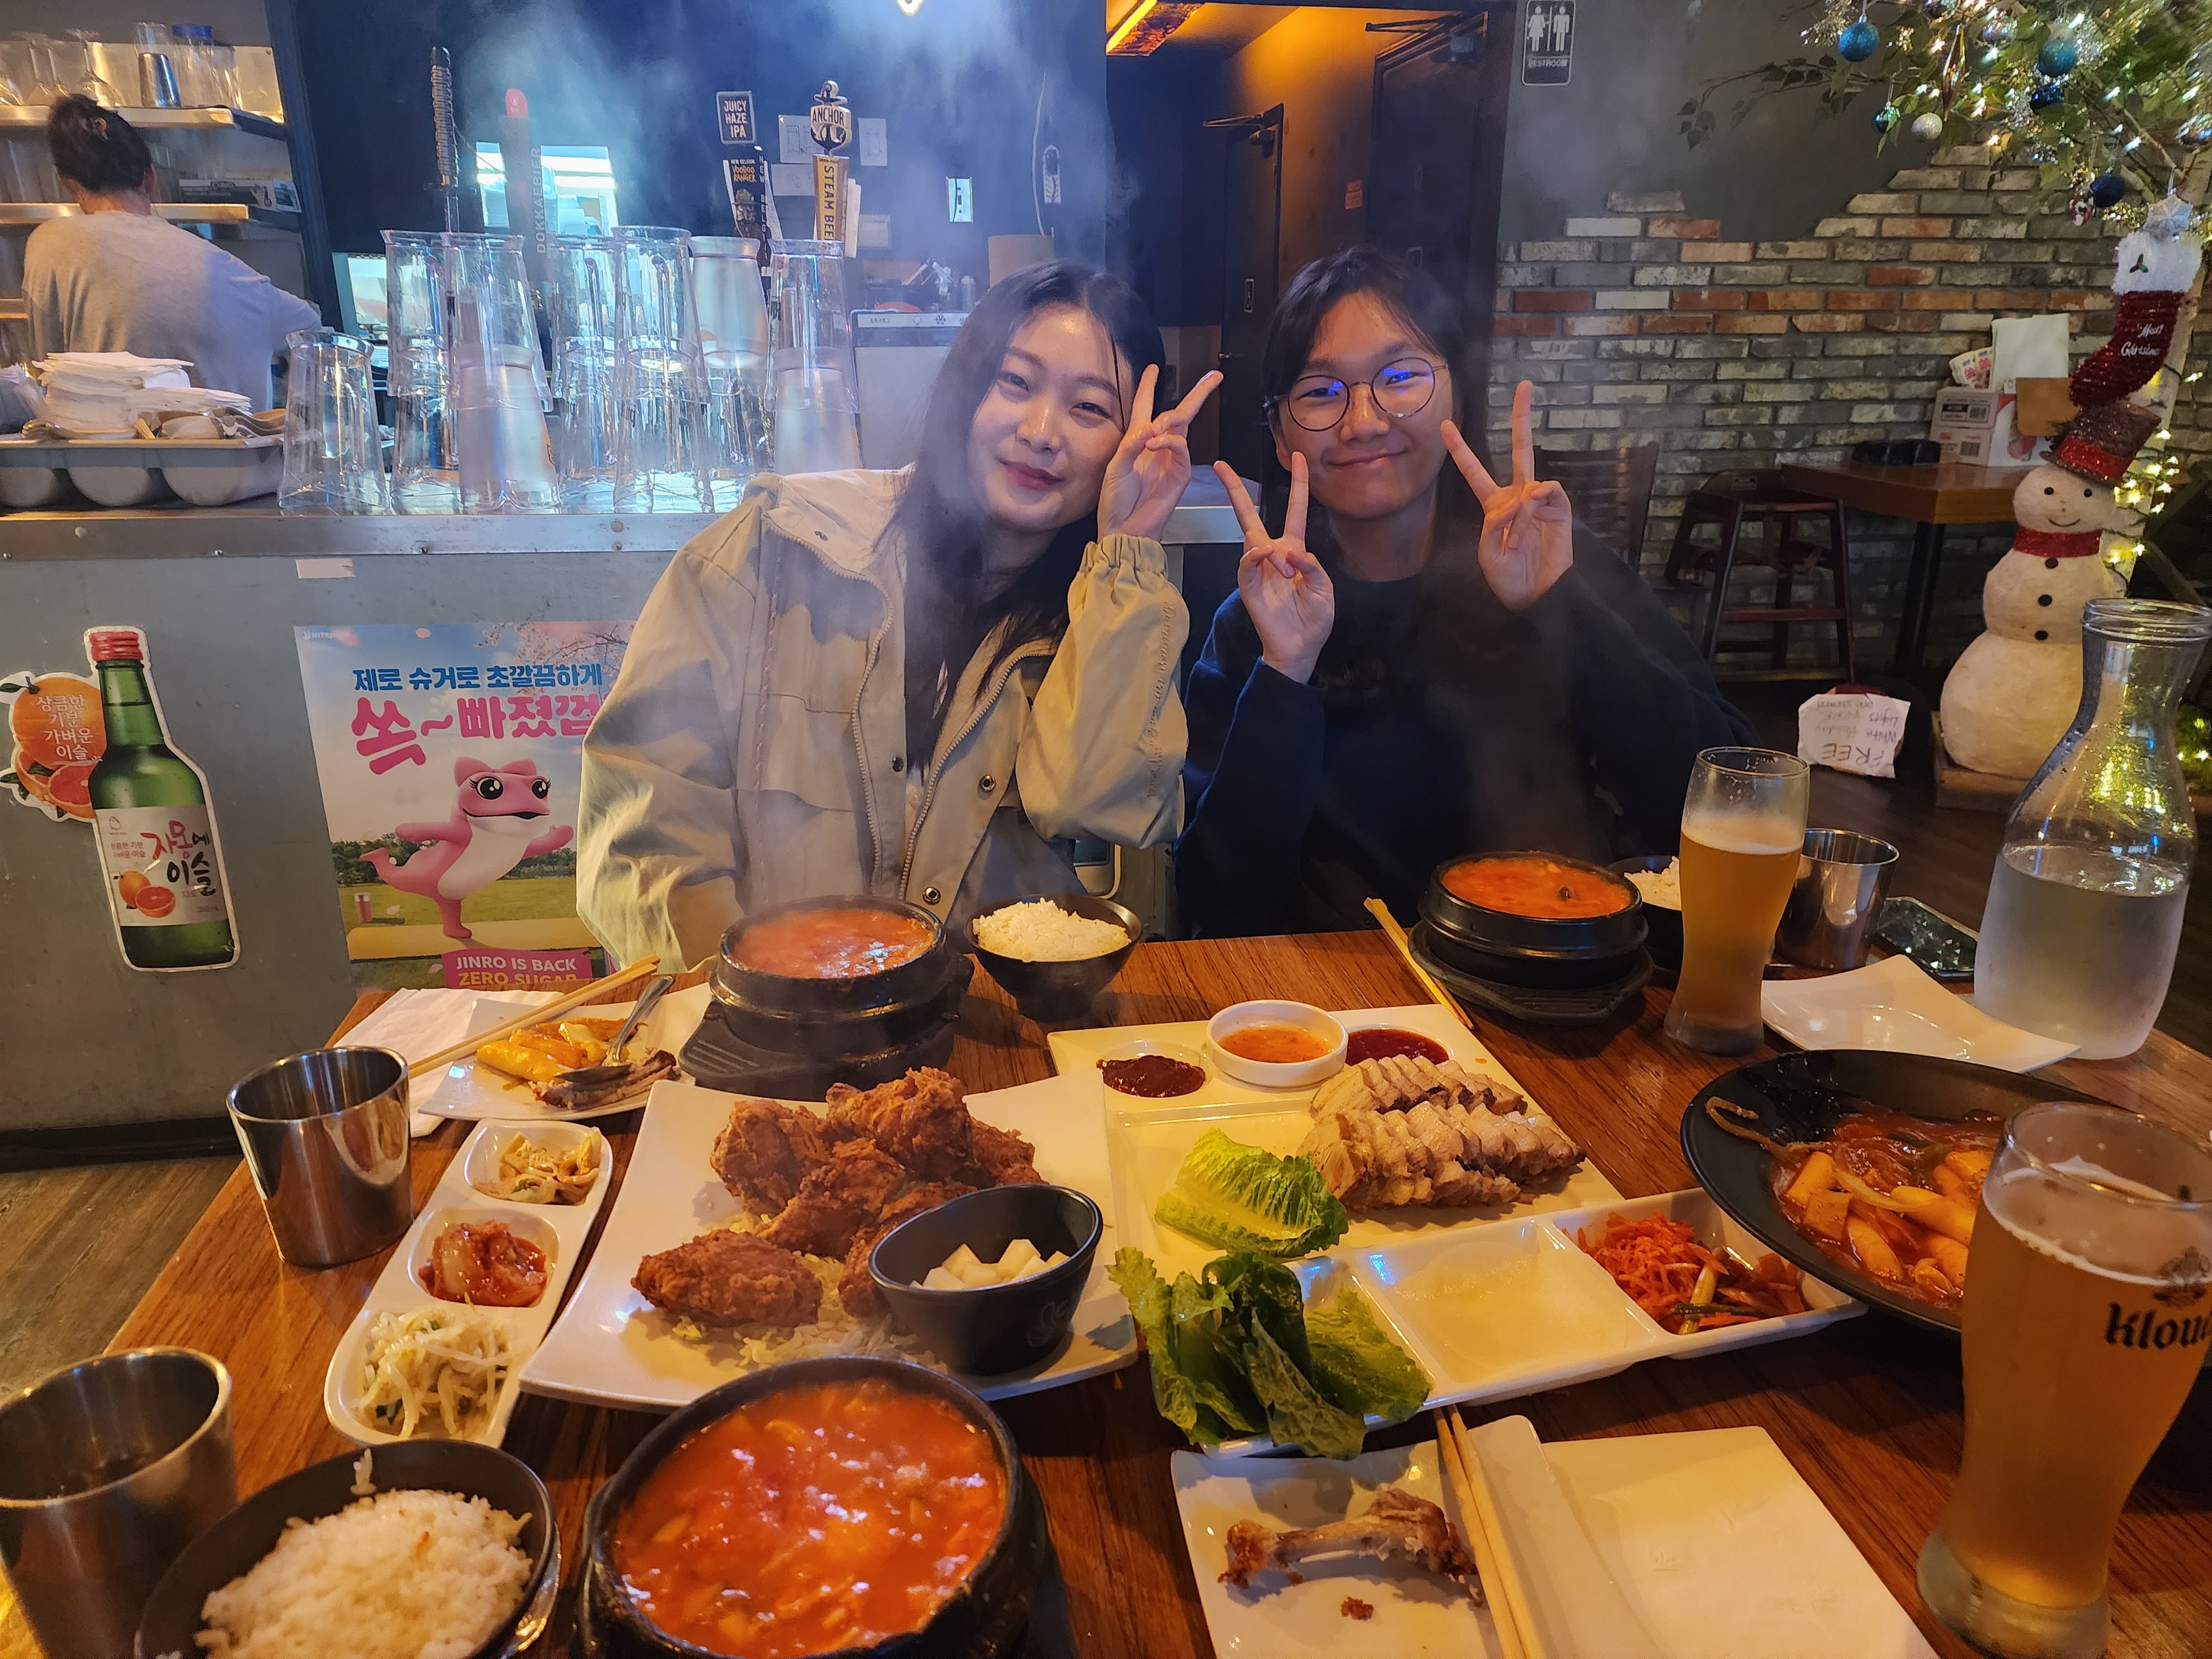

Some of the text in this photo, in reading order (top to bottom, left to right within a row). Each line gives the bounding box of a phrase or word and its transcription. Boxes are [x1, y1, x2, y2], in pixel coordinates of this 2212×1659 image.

[724, 100, 747, 112] JUICY
[725, 112, 748, 124] HAZE
[812, 107, 844, 127] ANCHOR
[731, 124, 747, 138] IPA
[732, 165, 755, 174] VOODOO
[733, 173, 757, 182] RANGER
[824, 165, 834, 210] STEAM
[531, 147, 546, 254] DOKKAEBIER
[352, 663, 603, 691] 제로 슈거로 초깔끔하게
[36, 695, 86, 712] 상큼한
[49, 712, 80, 728] 기분
[44, 727, 94, 744] 가벼운
[56, 744, 88, 760] 이슬
[1822, 743, 1885, 768] FREE
[456, 956, 577, 972] JINRO IS BACK
[458, 972, 509, 987] ZERO
